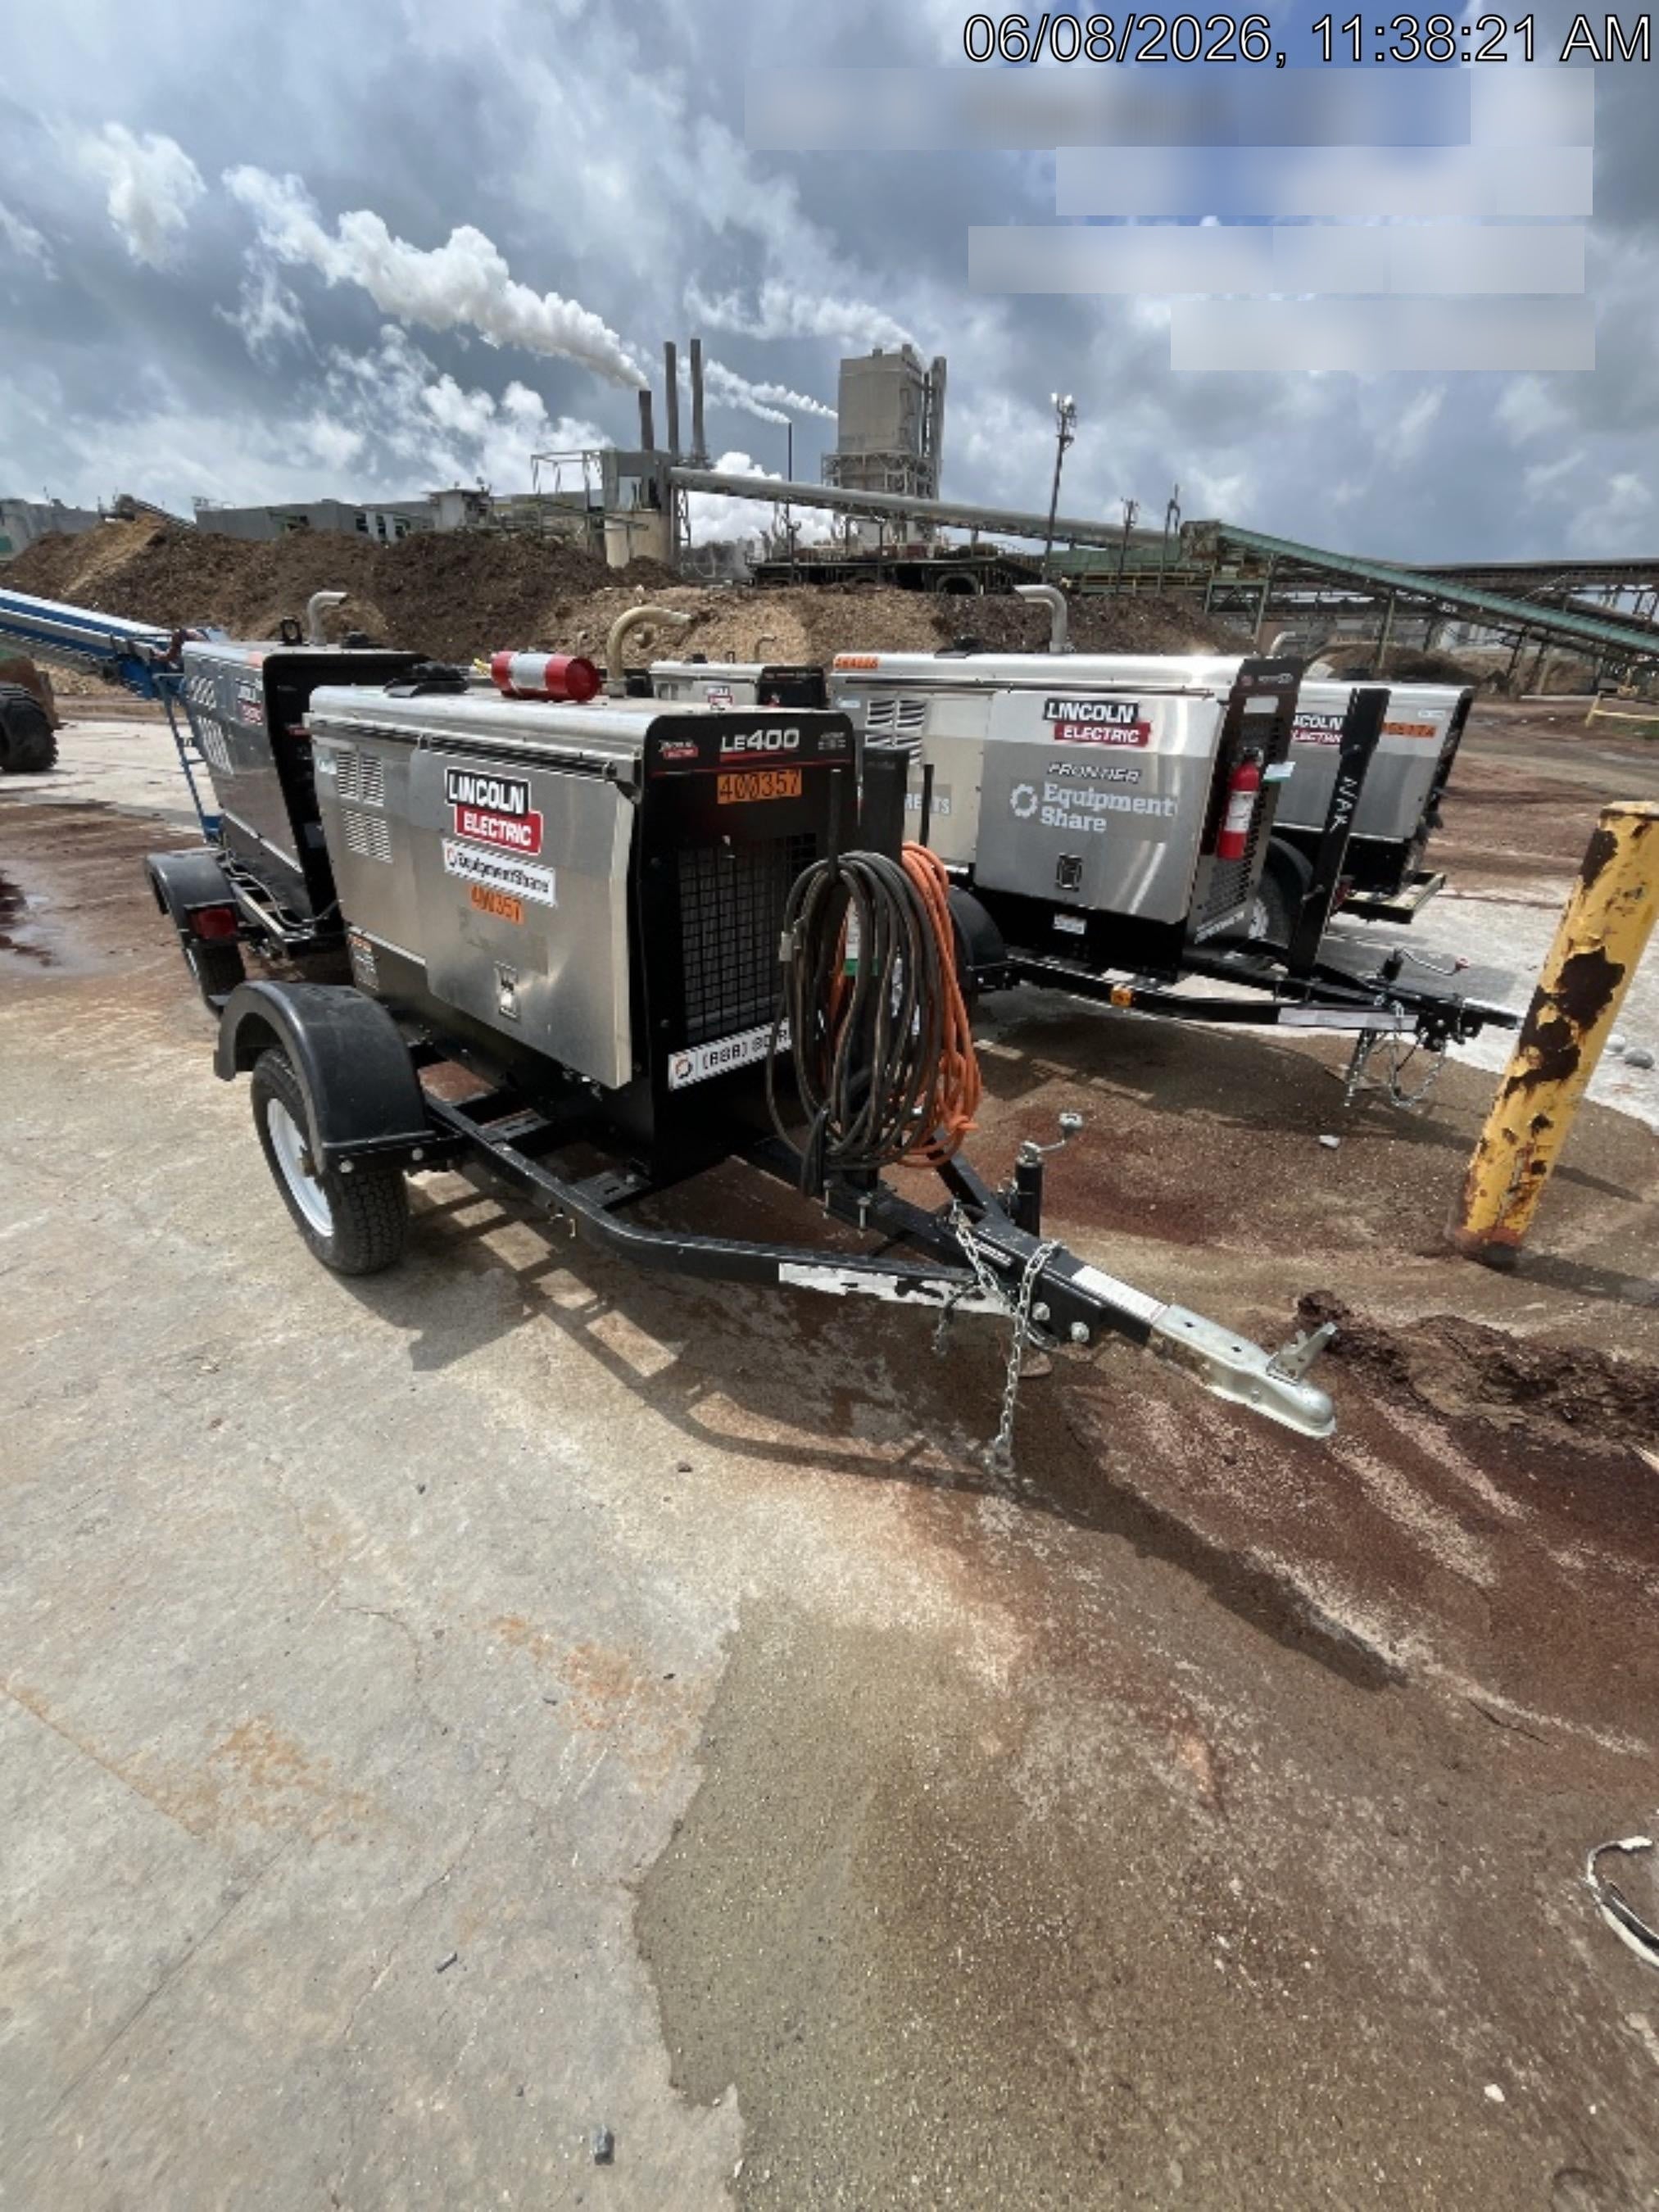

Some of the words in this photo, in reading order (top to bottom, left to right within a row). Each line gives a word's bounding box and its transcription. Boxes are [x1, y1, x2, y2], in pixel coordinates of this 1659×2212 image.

[1046, 701, 1134, 723] LINCOLN
[719, 728, 800, 753] LE400
[1063, 724, 1140, 743] ELECTRIC
[718, 768, 800, 800] 400357
[1047, 762, 1140, 784] FRONTIER
[448, 773, 525, 814] LINCOLN
[1043, 782, 1176, 817] Equipment
[464, 810, 532, 846] ELECTRIC
[1040, 806, 1107, 832] Share
